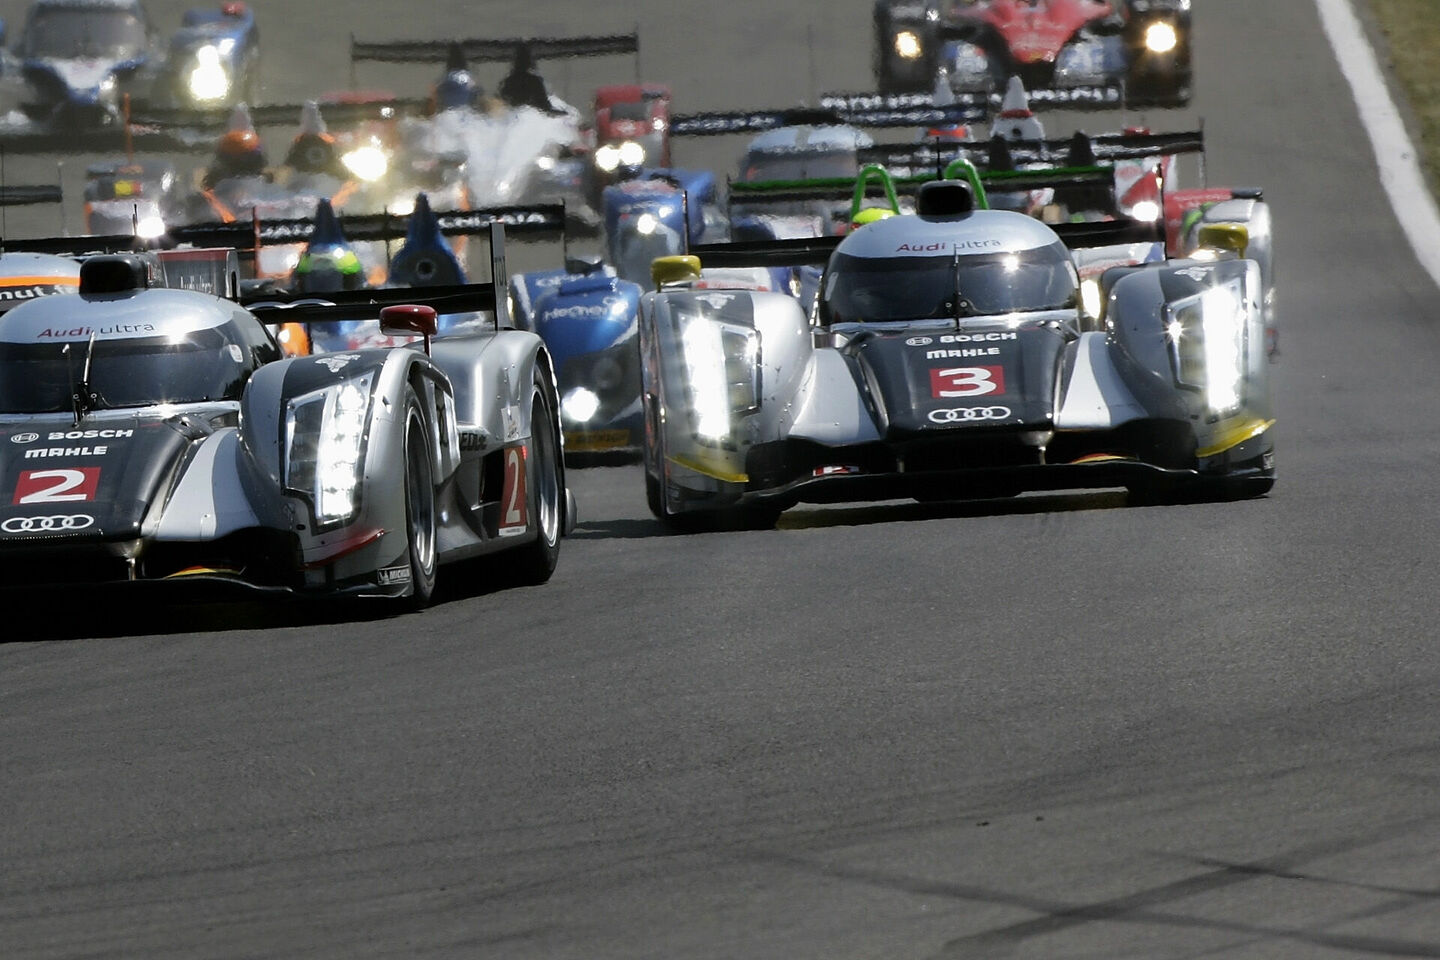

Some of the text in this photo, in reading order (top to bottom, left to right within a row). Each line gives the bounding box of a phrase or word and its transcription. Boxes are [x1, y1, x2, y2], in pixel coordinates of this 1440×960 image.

[896, 239, 1001, 253] Audi ultra
[37, 323, 156, 339] Audi ultra
[939, 333, 1017, 344] BOSCH
[926, 347, 1000, 360] MAHLE
[938, 367, 998, 398] 3
[48, 429, 134, 441] BOSCH
[24, 445, 108, 459] MAHLE
[19, 469, 88, 504] 2
[505, 449, 521, 524] 2
